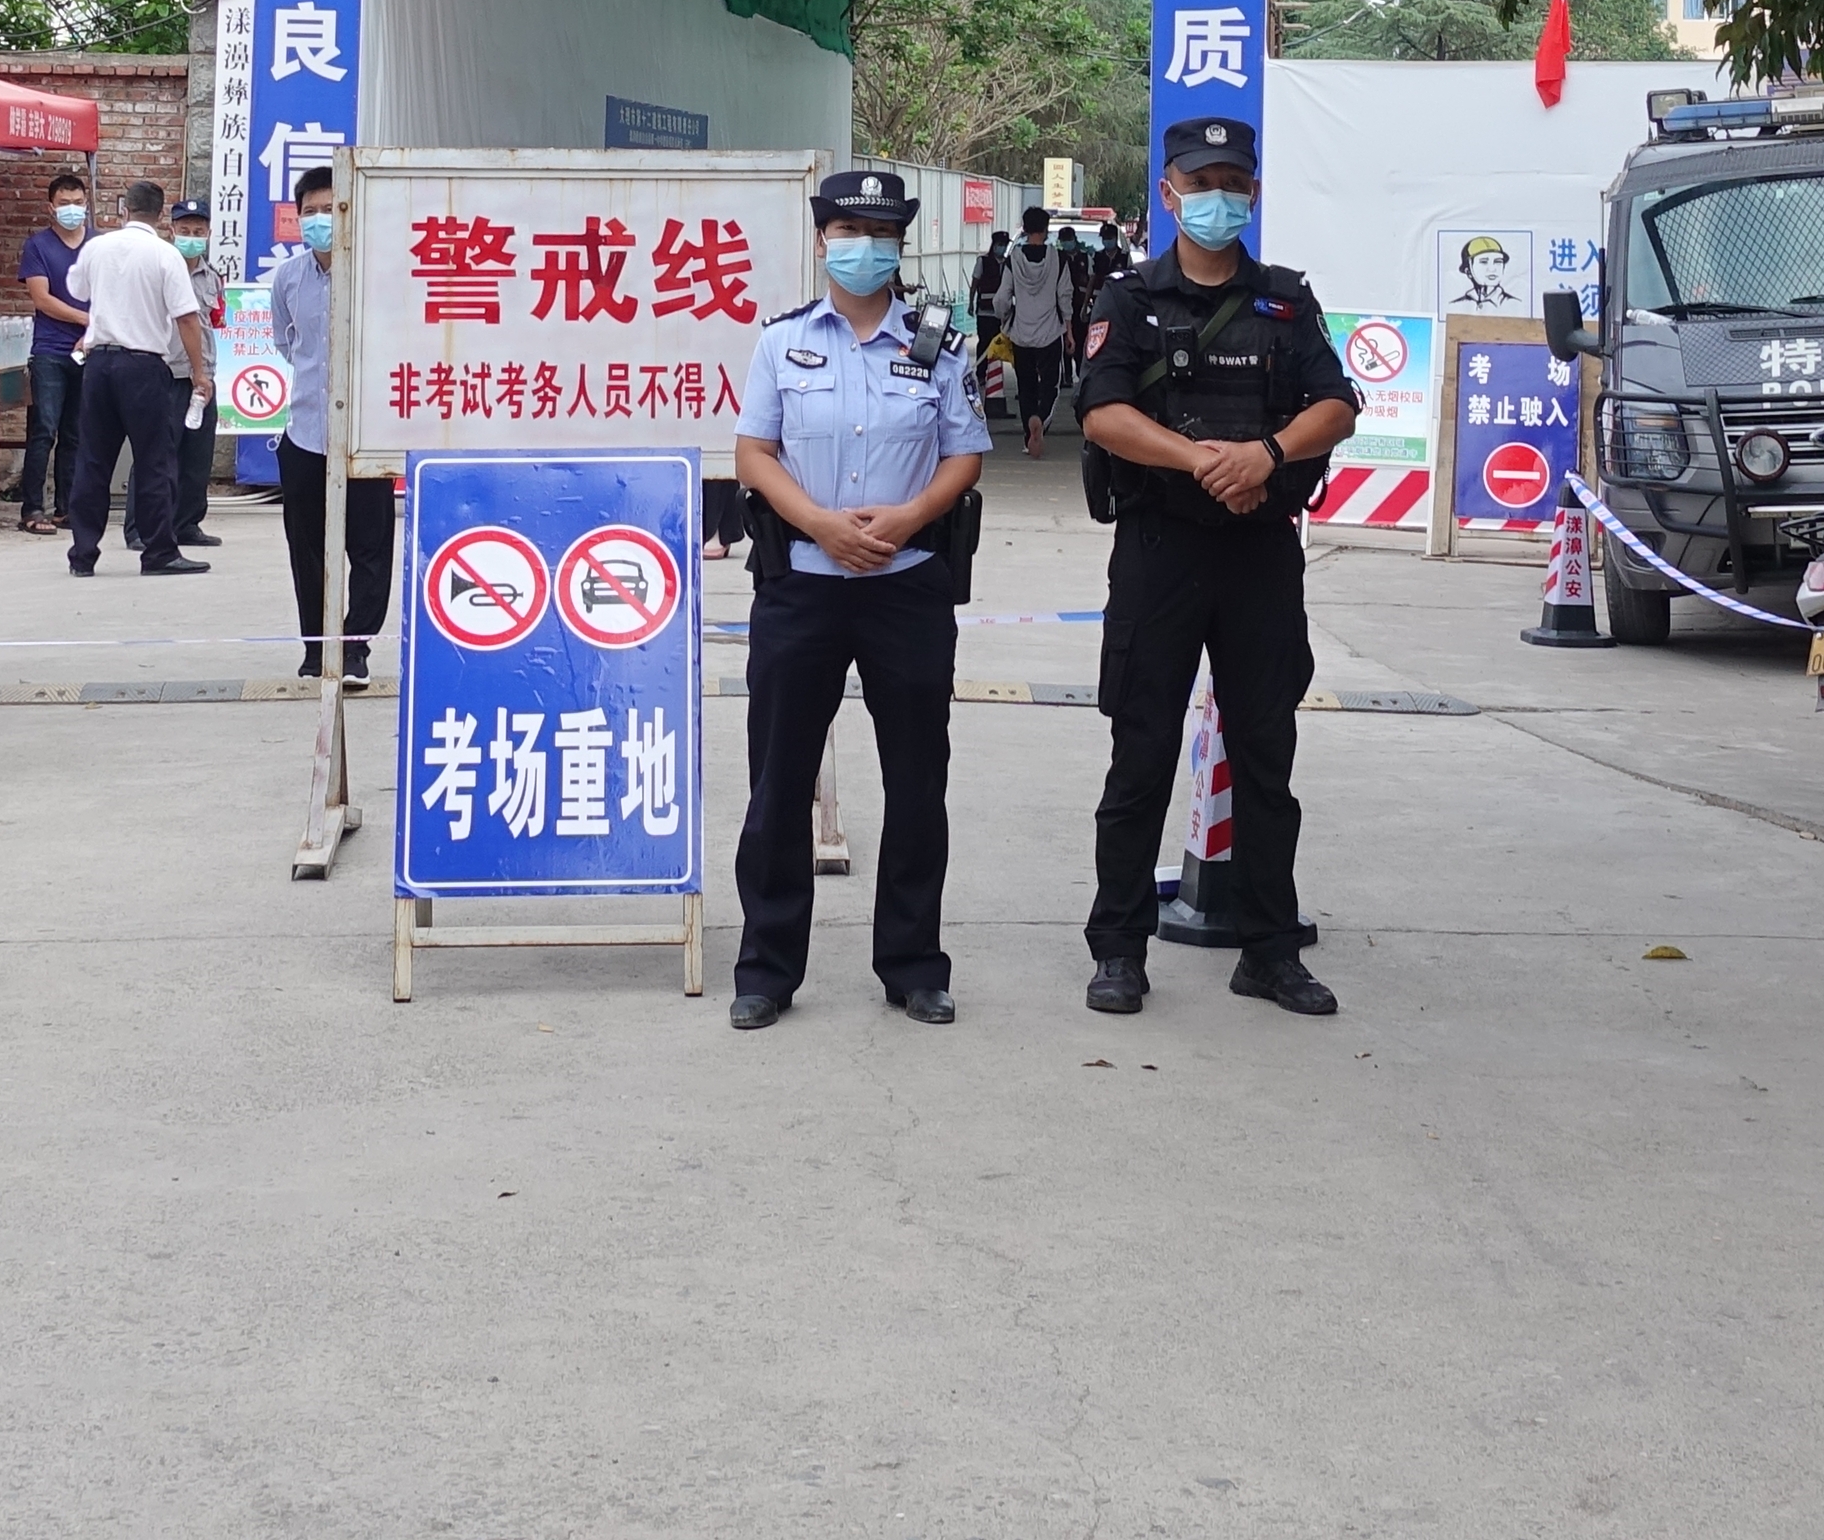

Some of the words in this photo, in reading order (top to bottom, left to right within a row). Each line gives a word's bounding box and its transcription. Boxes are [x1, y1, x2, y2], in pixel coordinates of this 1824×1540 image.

[216, 7, 250, 283] 漾濞彝族自治县第
[410, 216, 758, 324] 警戒线
[1558, 283, 1601, 317] 须
[389, 361, 741, 419] 非考试考务人员不得入
[1363, 390, 1424, 404] 入无烟校园
[1363, 405, 1399, 418] 勿吸烟
[1468, 394, 1569, 428] 禁止驶入
[1565, 516, 1582, 598] 漾濞公安
[422, 707, 679, 841] 考场重地
